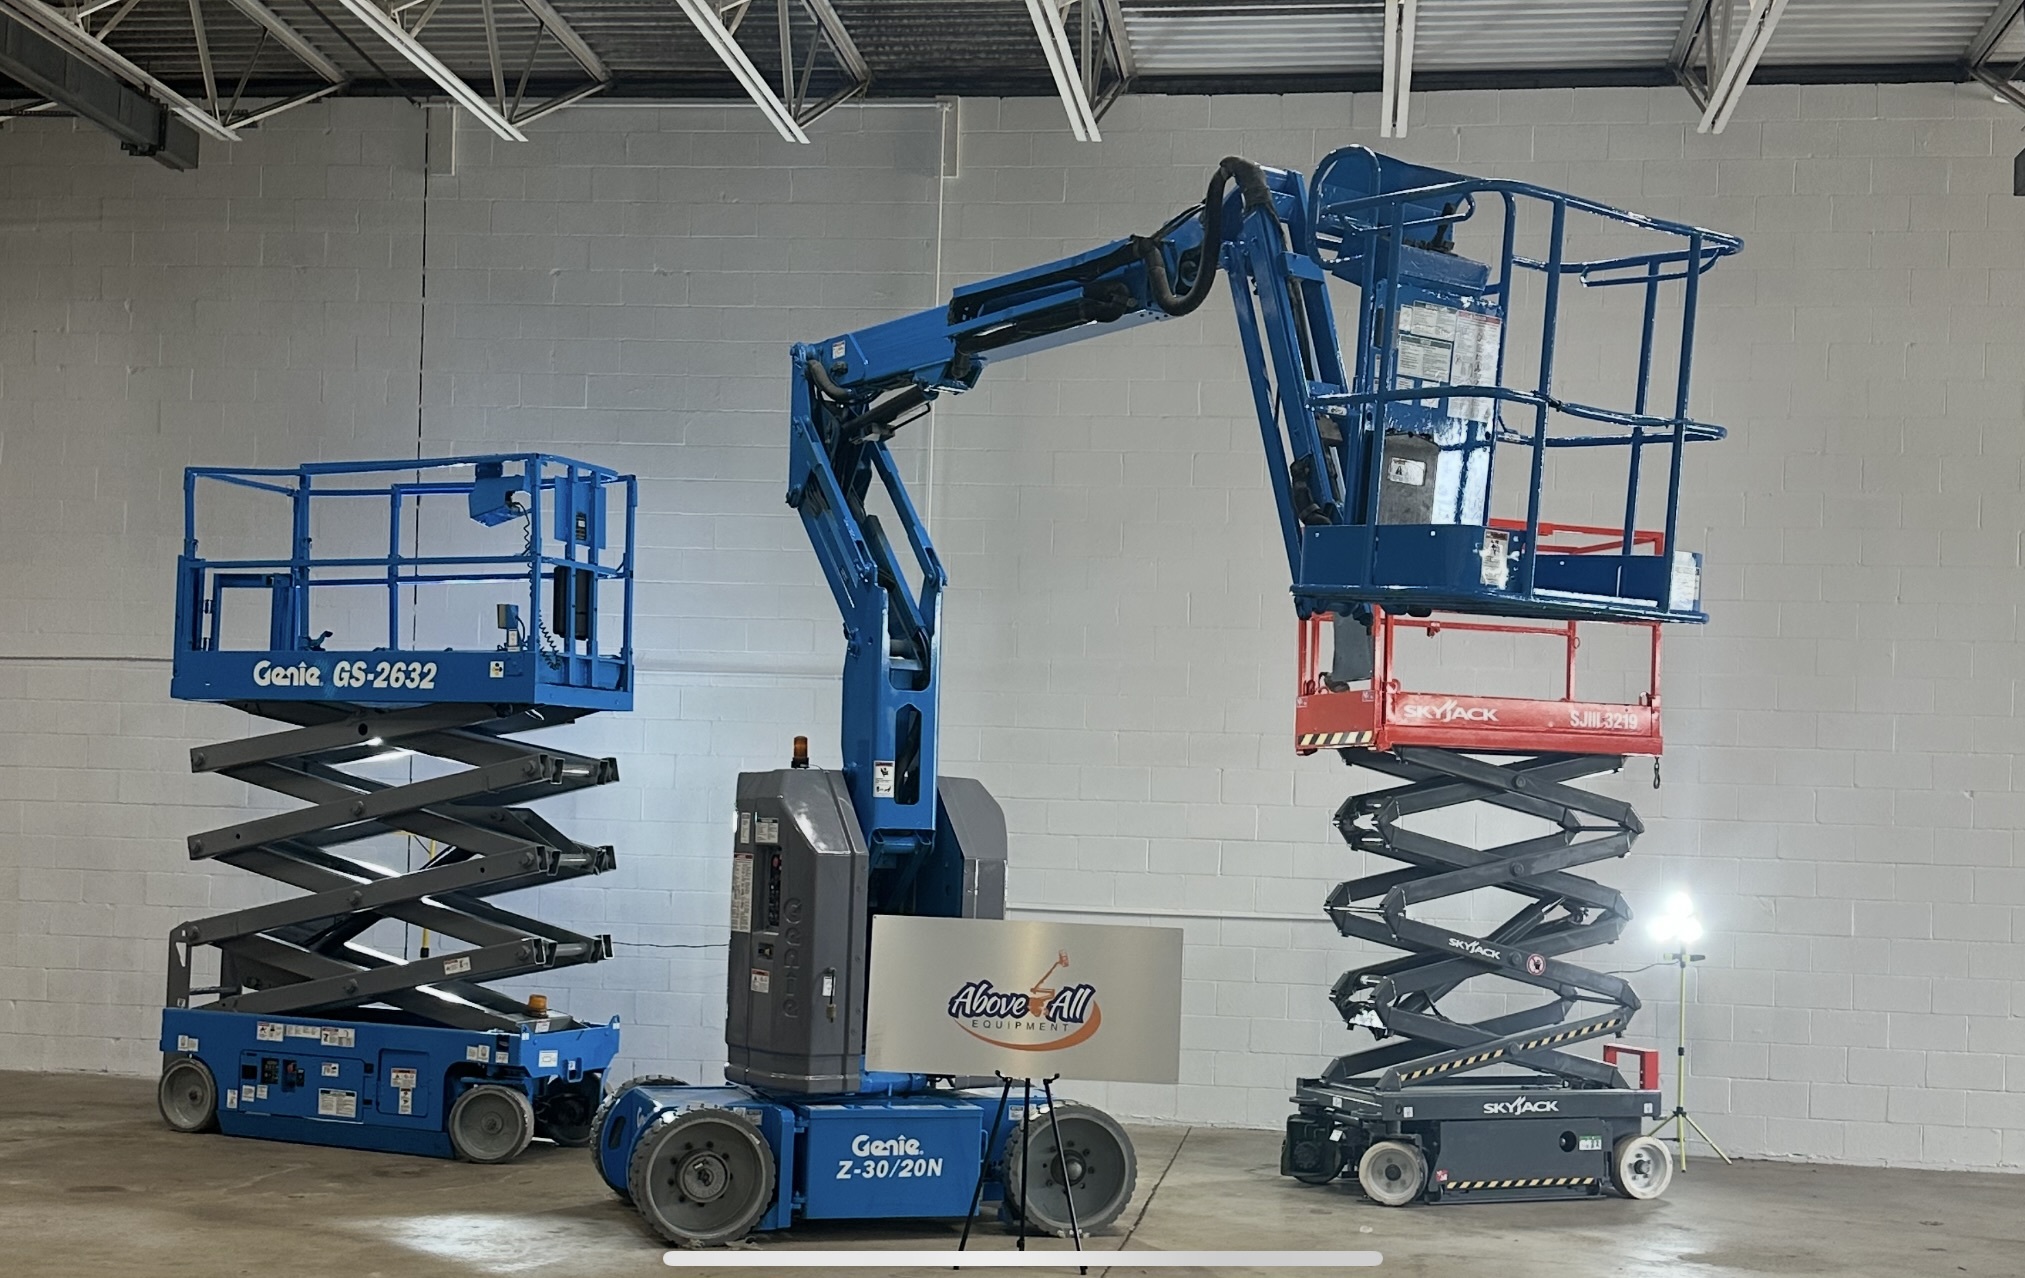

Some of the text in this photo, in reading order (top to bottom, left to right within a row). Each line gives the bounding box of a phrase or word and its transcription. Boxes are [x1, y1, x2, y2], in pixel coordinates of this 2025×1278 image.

[252, 660, 438, 690] Genie GS-2632
[1402, 700, 1499, 722] SKYJACK
[1604, 712, 1638, 730] 3219
[1448, 938, 1501, 960] SKYJACK
[948, 980, 1096, 1023] Above All
[971, 1019, 1069, 1032] EQUIPMENT
[1483, 1096, 1559, 1116] SKYJACK
[851, 1134, 924, 1157] Genie
[835, 1158, 944, 1180] Z-30/20N
